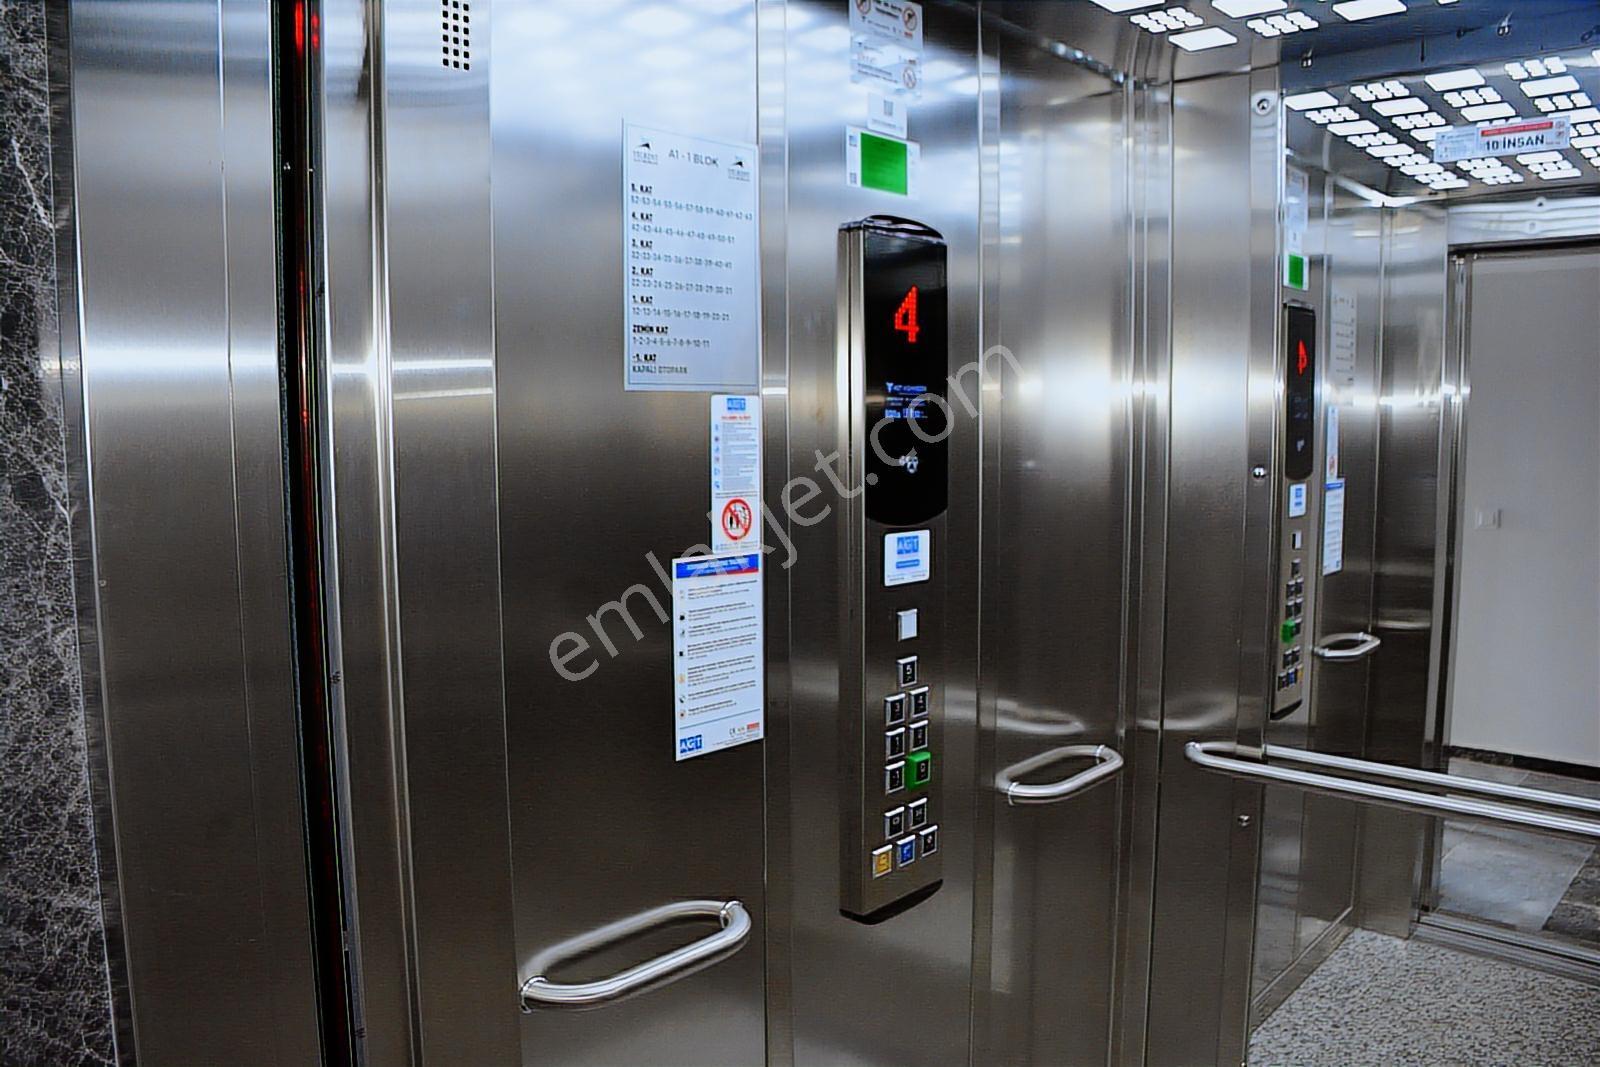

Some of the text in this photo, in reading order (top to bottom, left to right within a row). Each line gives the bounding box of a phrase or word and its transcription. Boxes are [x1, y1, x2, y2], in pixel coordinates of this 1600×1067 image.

[1485, 140, 1499, 151] 10
[1502, 134, 1545, 149] İNSAN
[668, 149, 679, 159] A1
[687, 152, 692, 162] 1
[693, 154, 719, 168] BLOK
[640, 212, 653, 223] KAT
[640, 240, 653, 250] KAT
[640, 267, 654, 277] KAT
[640, 296, 653, 305] KAT
[893, 283, 920, 345] 4
[656, 325, 669, 335] KAT
[644, 353, 657, 363] KAT
